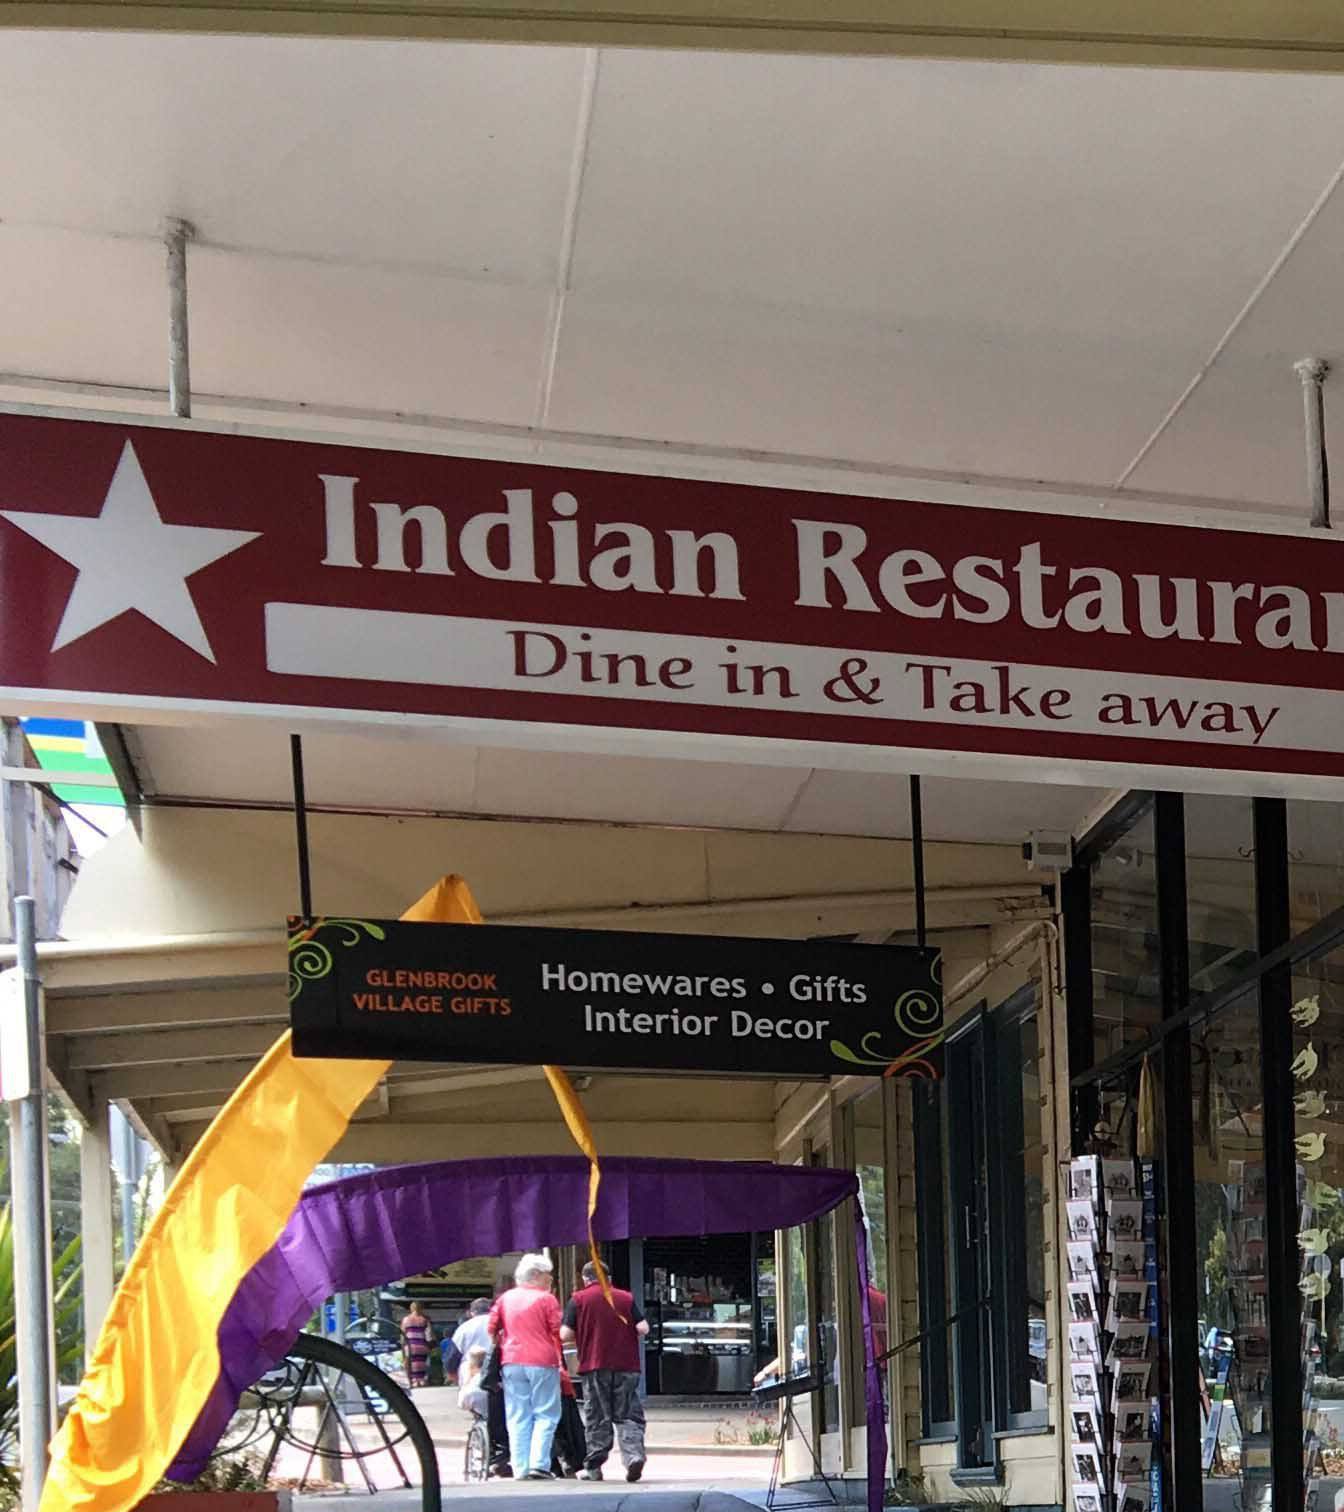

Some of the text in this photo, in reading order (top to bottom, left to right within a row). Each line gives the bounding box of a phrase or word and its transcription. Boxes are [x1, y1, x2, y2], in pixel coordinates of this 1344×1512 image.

[316, 473, 747, 602] Indian
[508, 629, 1281, 745] Dine in & Take away
[366, 969, 498, 991] GLENBROOK
[541, 963, 868, 1004] Homewares Gifts
[352, 993, 513, 1017] VILLAGE GIFTS
[584, 1005, 830, 1040] Interior Decor
